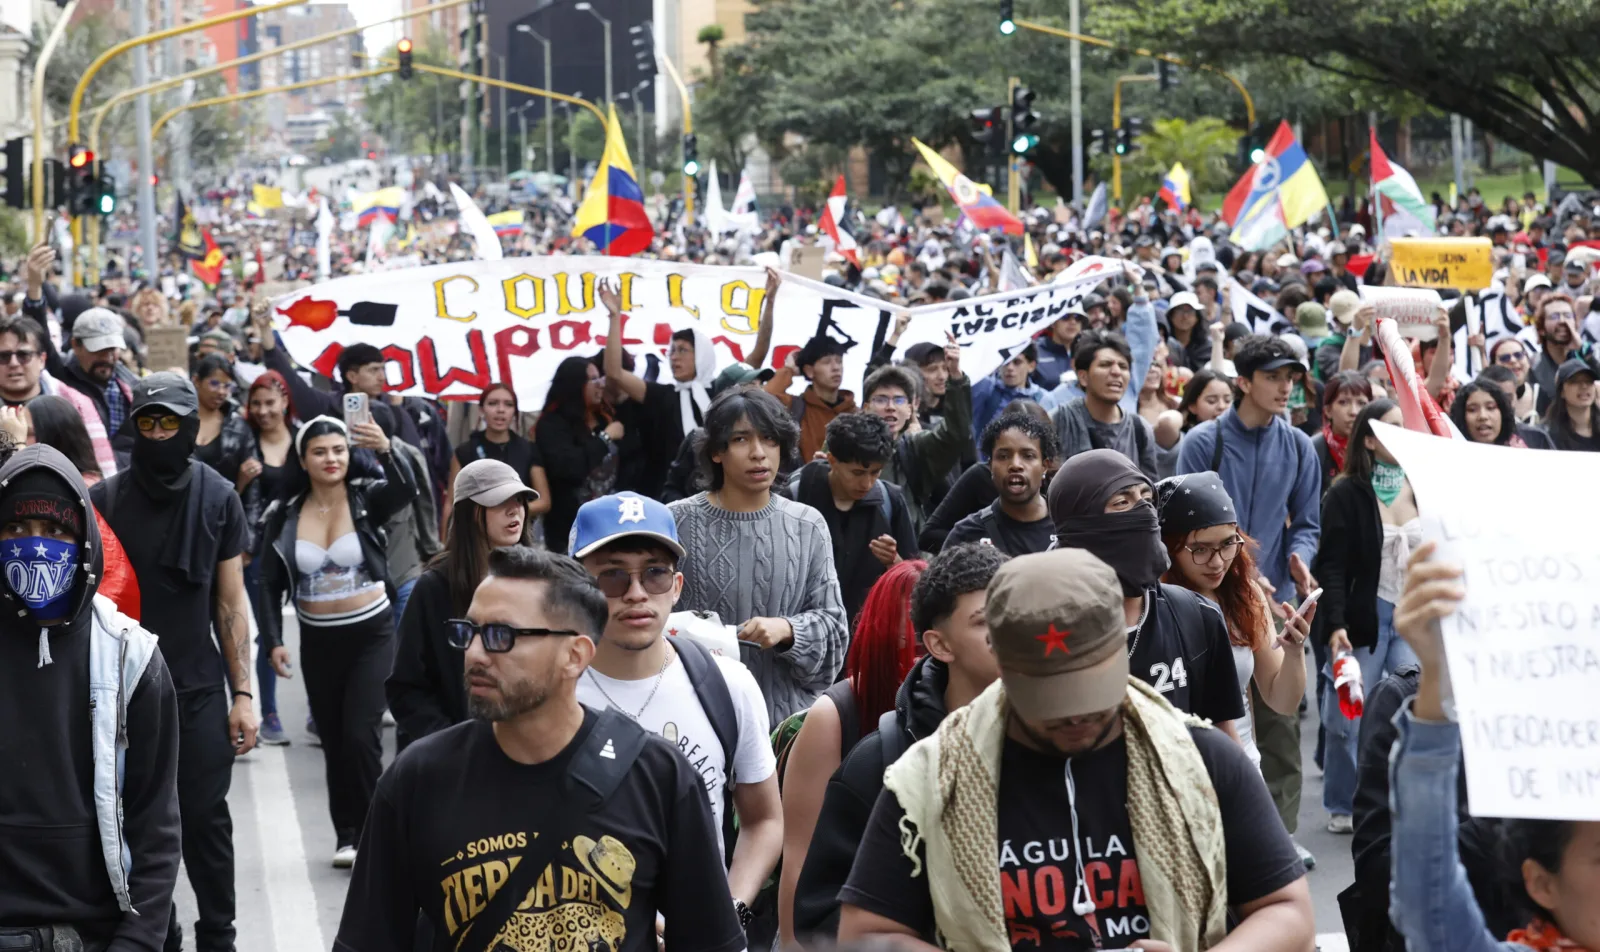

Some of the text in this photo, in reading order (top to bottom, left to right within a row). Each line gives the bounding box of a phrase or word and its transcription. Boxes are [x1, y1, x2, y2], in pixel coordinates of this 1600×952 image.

[1402, 267, 1449, 285] LA VIDA
[1150, 657, 1188, 693] 24
[1508, 766, 1542, 799] DE
[466, 831, 527, 858] SOMOS
[1000, 834, 1127, 868] ÁGULA
[1000, 864, 1067, 919] NO
